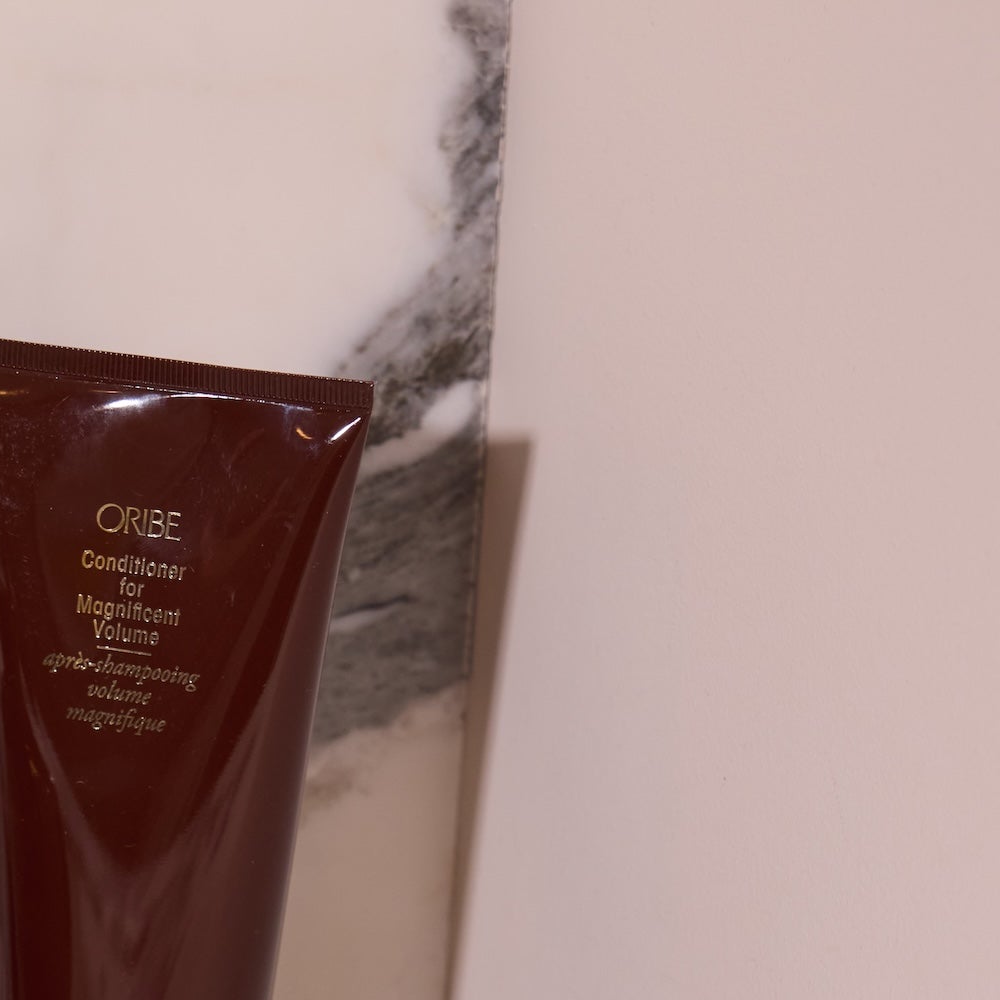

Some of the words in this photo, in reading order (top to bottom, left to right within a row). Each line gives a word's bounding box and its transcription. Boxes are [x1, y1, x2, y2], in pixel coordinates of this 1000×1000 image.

[96, 503, 182, 542] ORIBE
[81, 549, 187, 581] Conditioner
[119, 576, 145, 598] for
[76, 593, 181, 626] Magnificent
[93, 618, 160, 646] Volume
[42, 651, 200, 693] après-shampooing
[87, 680, 152, 705] volume
[65, 706, 167, 736] magnifique
